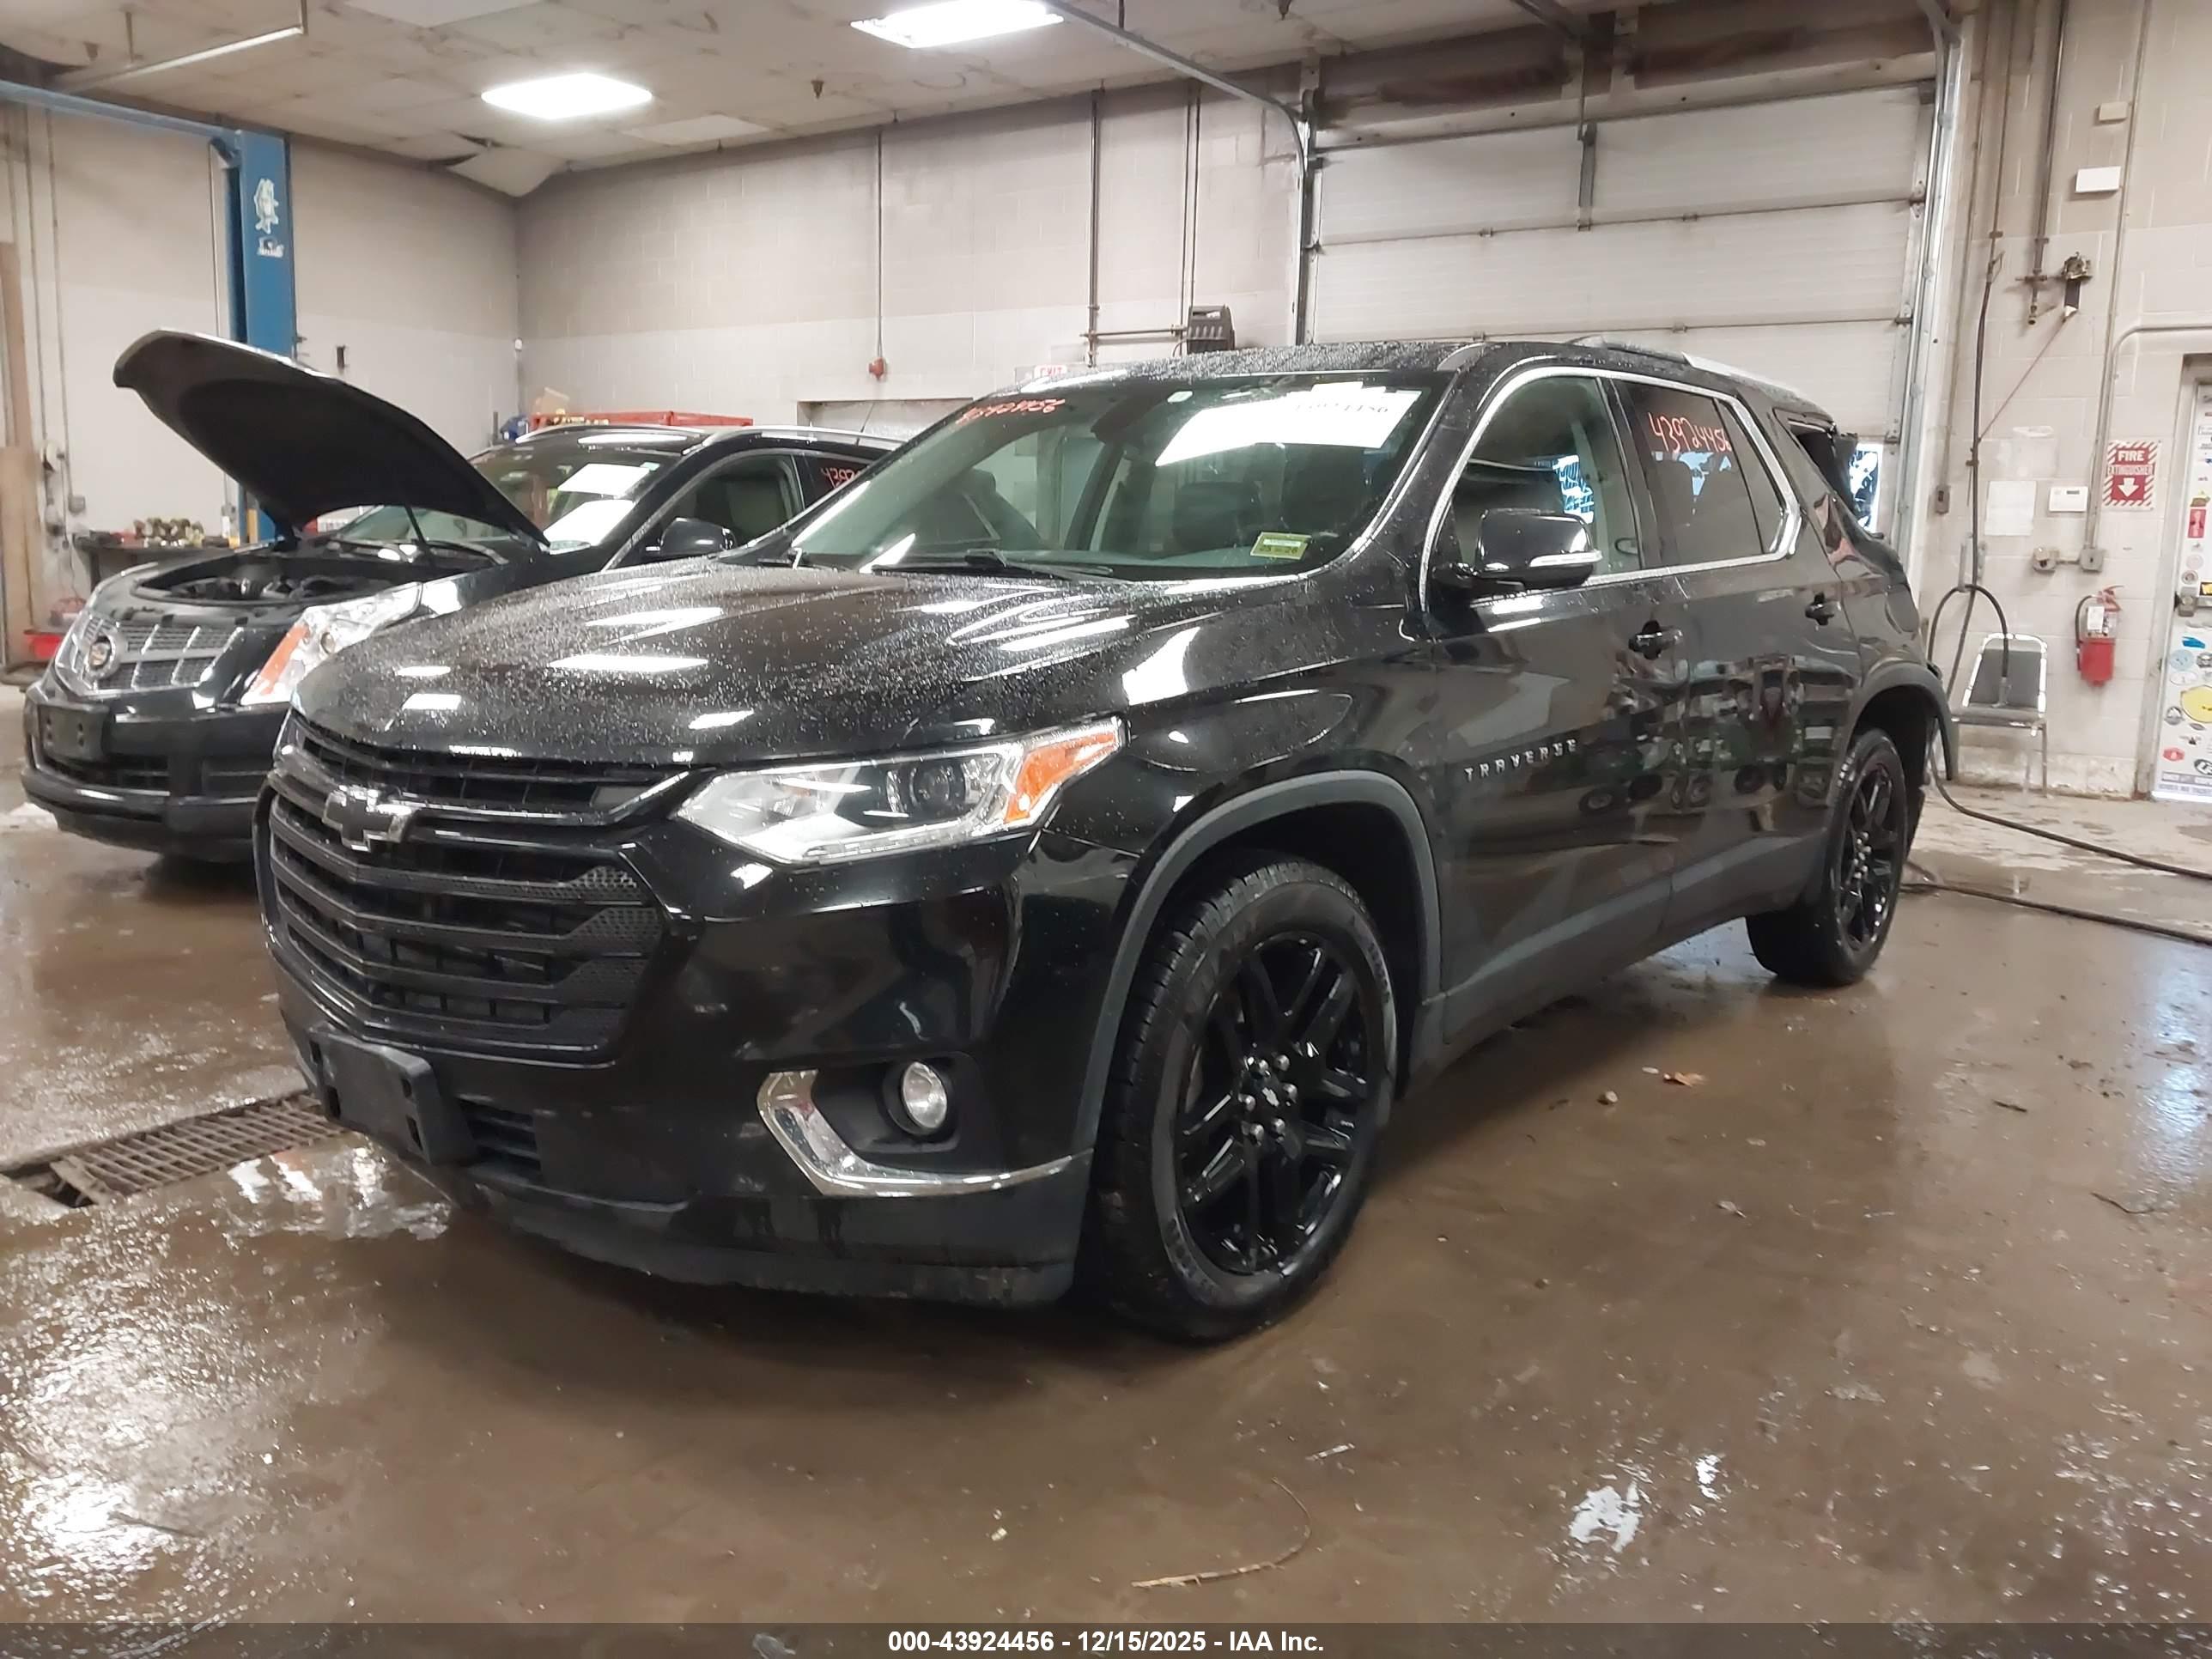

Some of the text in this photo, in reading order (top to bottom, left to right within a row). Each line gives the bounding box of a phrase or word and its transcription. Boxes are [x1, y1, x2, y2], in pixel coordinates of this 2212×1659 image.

[1647, 411, 1732, 453] 43924456
[2118, 450, 2145, 462] FIRE
[1463, 738, 1577, 782] TRAVERSE
